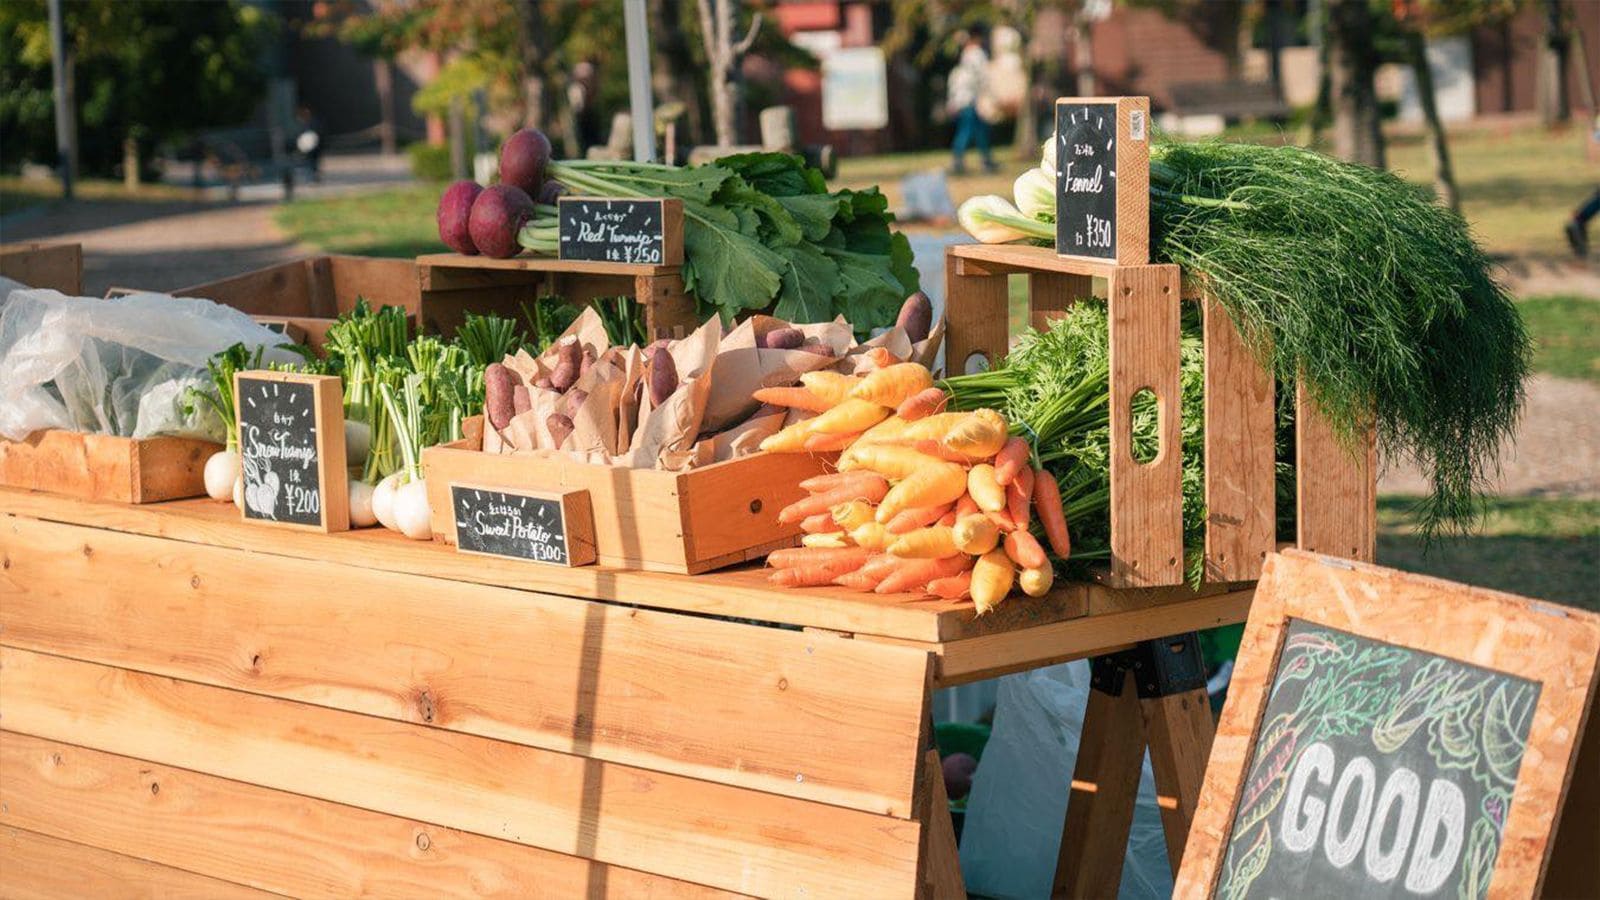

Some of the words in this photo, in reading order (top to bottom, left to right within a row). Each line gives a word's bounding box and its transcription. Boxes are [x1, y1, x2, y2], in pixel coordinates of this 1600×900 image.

[1064, 161, 1104, 193] Fennel
[577, 220, 606, 243] Red
[606, 224, 654, 251] Turnip
[1086, 213, 1112, 248] ¥350
[624, 245, 660, 264] ¥250
[284, 483, 320, 515] ¥200
[474, 510, 512, 537] Sweet
[511, 515, 552, 544] Potato
[1280, 741, 1467, 894] GOOD
